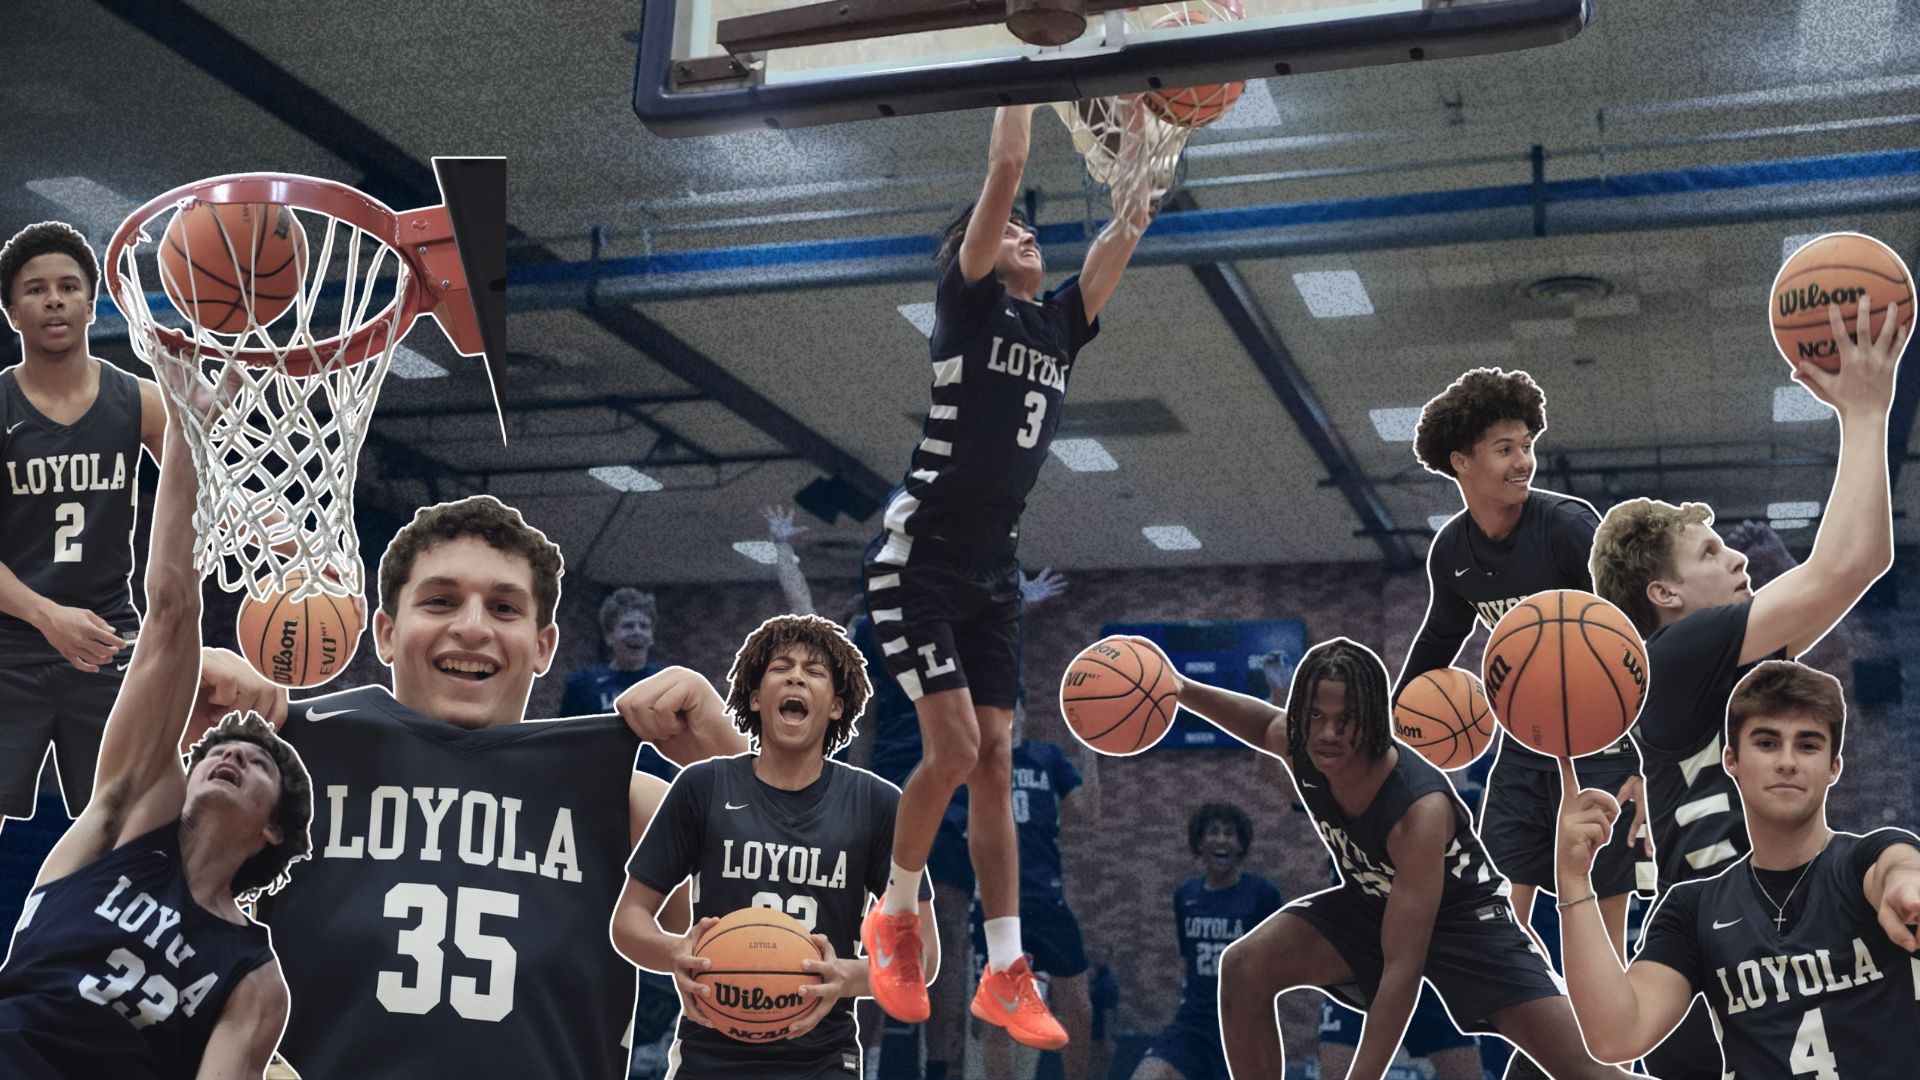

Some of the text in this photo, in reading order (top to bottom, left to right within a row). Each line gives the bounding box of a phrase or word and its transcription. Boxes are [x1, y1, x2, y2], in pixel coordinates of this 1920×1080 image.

[1778, 282, 1866, 317] Wilson
[1016, 390, 1047, 449] 3
[6, 452, 126, 495] LOYOLA
[53, 502, 85, 563] 2
[272, 619, 299, 685] Wilson
[917, 642, 957, 679] L
[323, 784, 583, 883] LOYOLA
[721, 839, 848, 889] LOYOLA
[376, 882, 520, 1023] 35
[748, 941, 778, 950] LOYOLA
[1184, 916, 1245, 939] LOYOLA
[714, 981, 804, 1011] Wilson
[1716, 936, 1885, 1016] LOYOLA
[1789, 1006, 1841, 1080] 4
